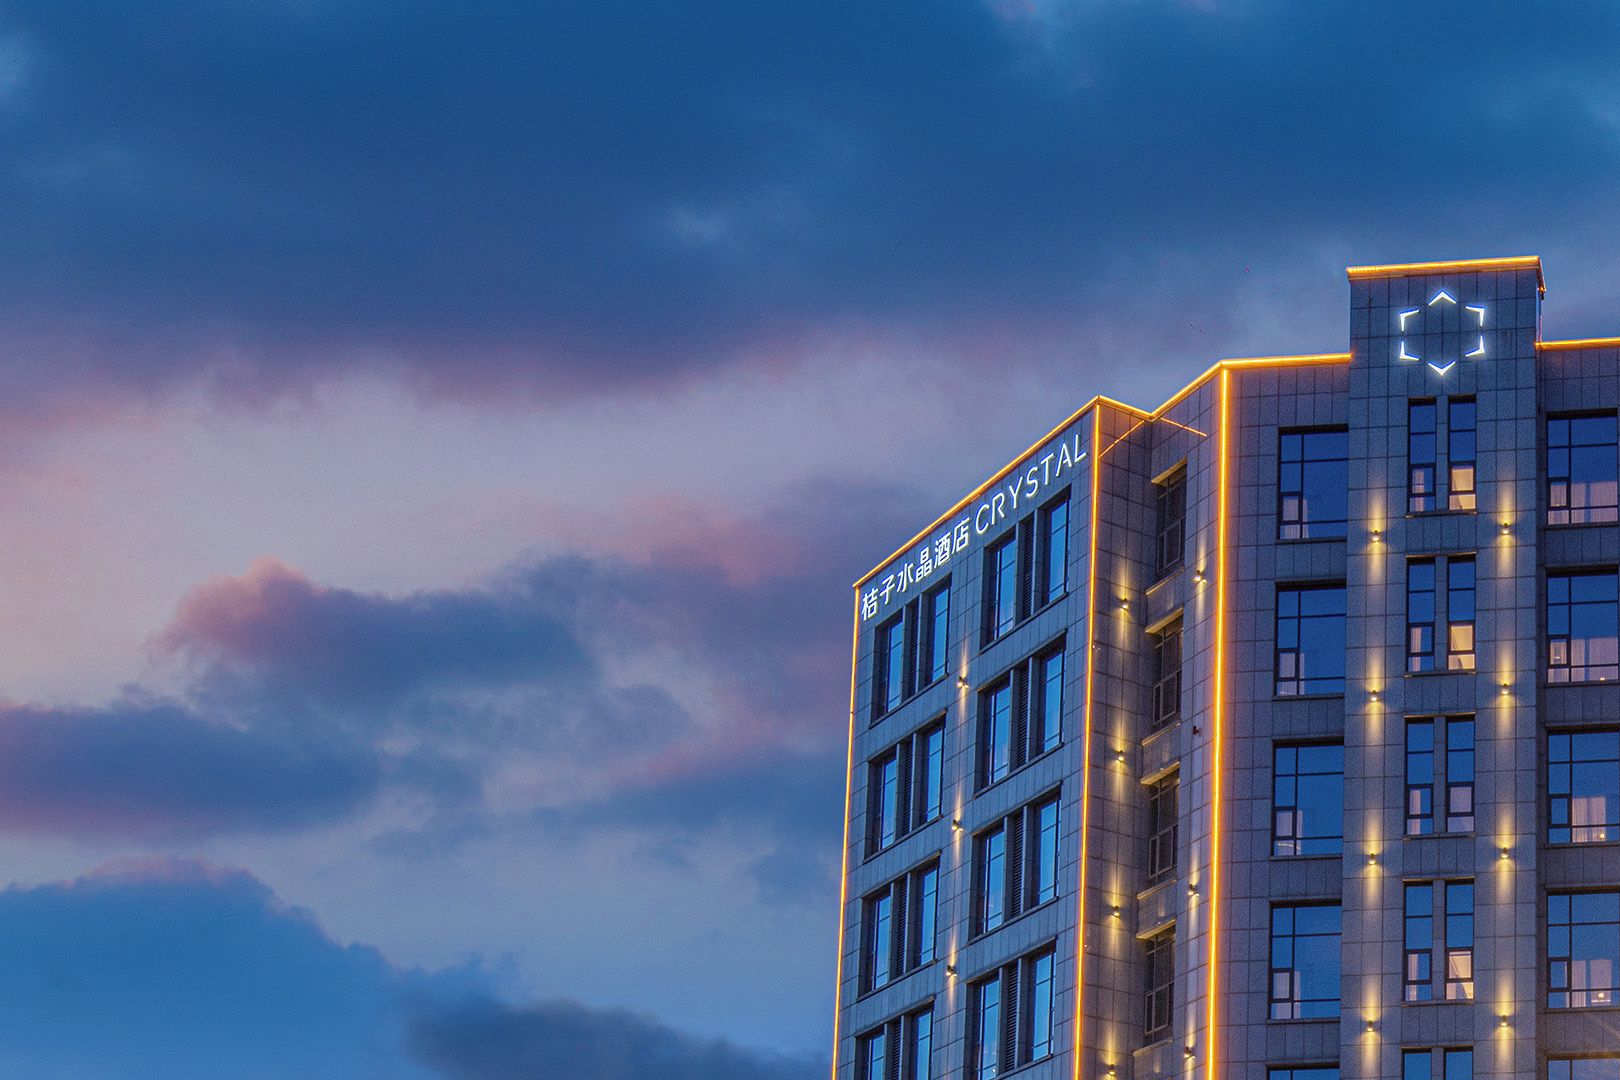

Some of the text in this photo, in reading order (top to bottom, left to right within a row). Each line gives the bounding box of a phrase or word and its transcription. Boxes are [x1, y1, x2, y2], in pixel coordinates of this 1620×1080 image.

[860, 433, 1088, 622] 桔子水晶酒店 CRYSTAL
